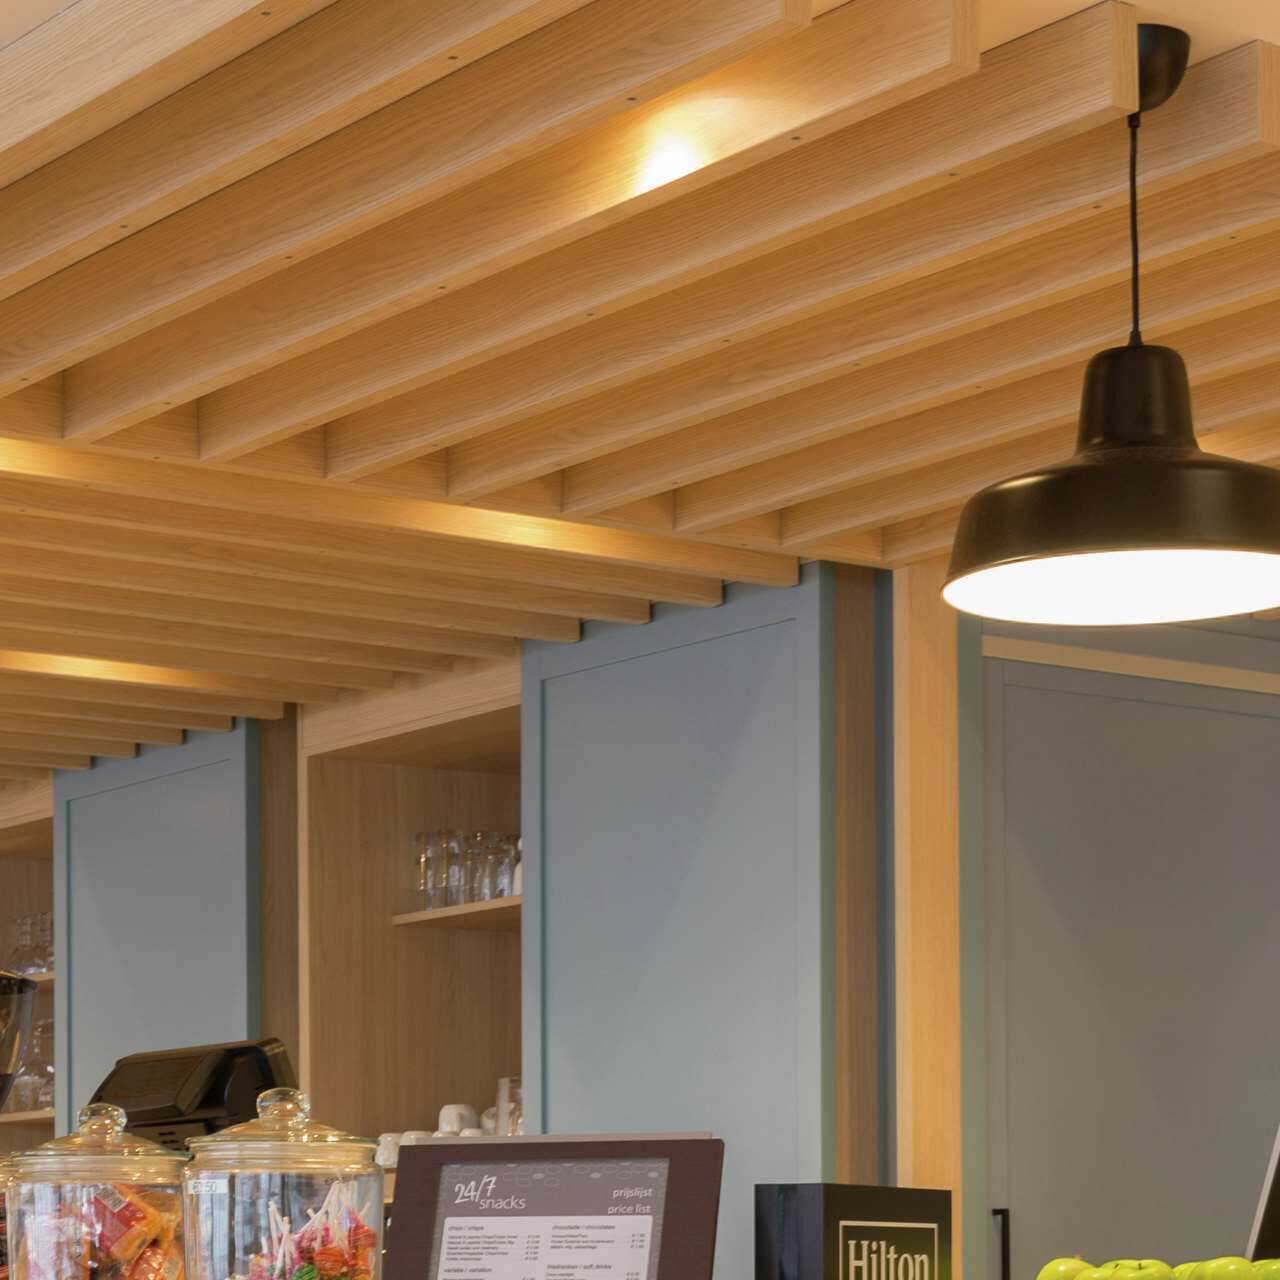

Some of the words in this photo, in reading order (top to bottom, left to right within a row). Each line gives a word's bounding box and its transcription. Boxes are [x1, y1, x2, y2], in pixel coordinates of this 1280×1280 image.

[454, 1174, 497, 1204] 24/7
[612, 1186, 653, 1199] prijslijst
[479, 1196, 526, 1210] snacks
[607, 1204, 635, 1215] price
[636, 1203, 651, 1214] list
